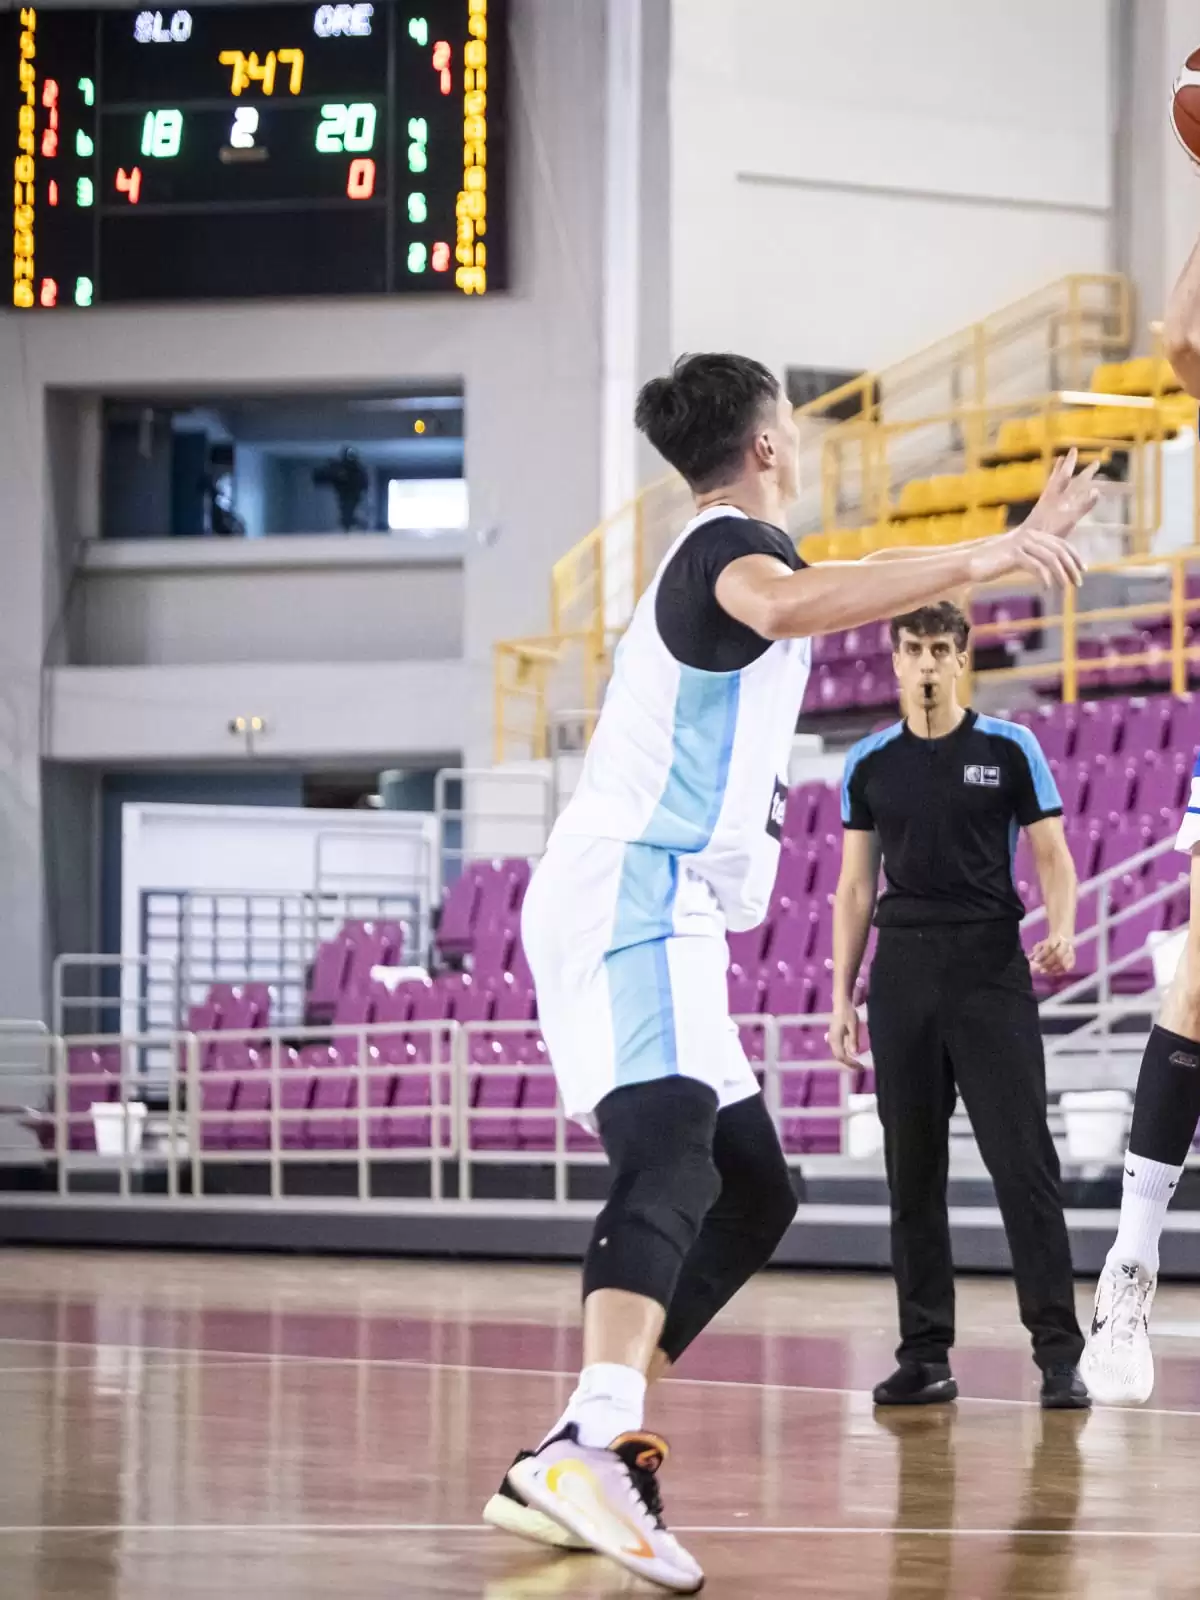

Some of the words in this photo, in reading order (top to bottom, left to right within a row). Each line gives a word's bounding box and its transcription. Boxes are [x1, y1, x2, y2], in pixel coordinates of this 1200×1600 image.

[134, 10, 193, 43] SLO
[141, 109, 184, 158] 18
[230, 106, 259, 149] 2
[315, 102, 377, 154] 20
[115, 166, 142, 204] 4
[347, 158, 376, 200] 0
